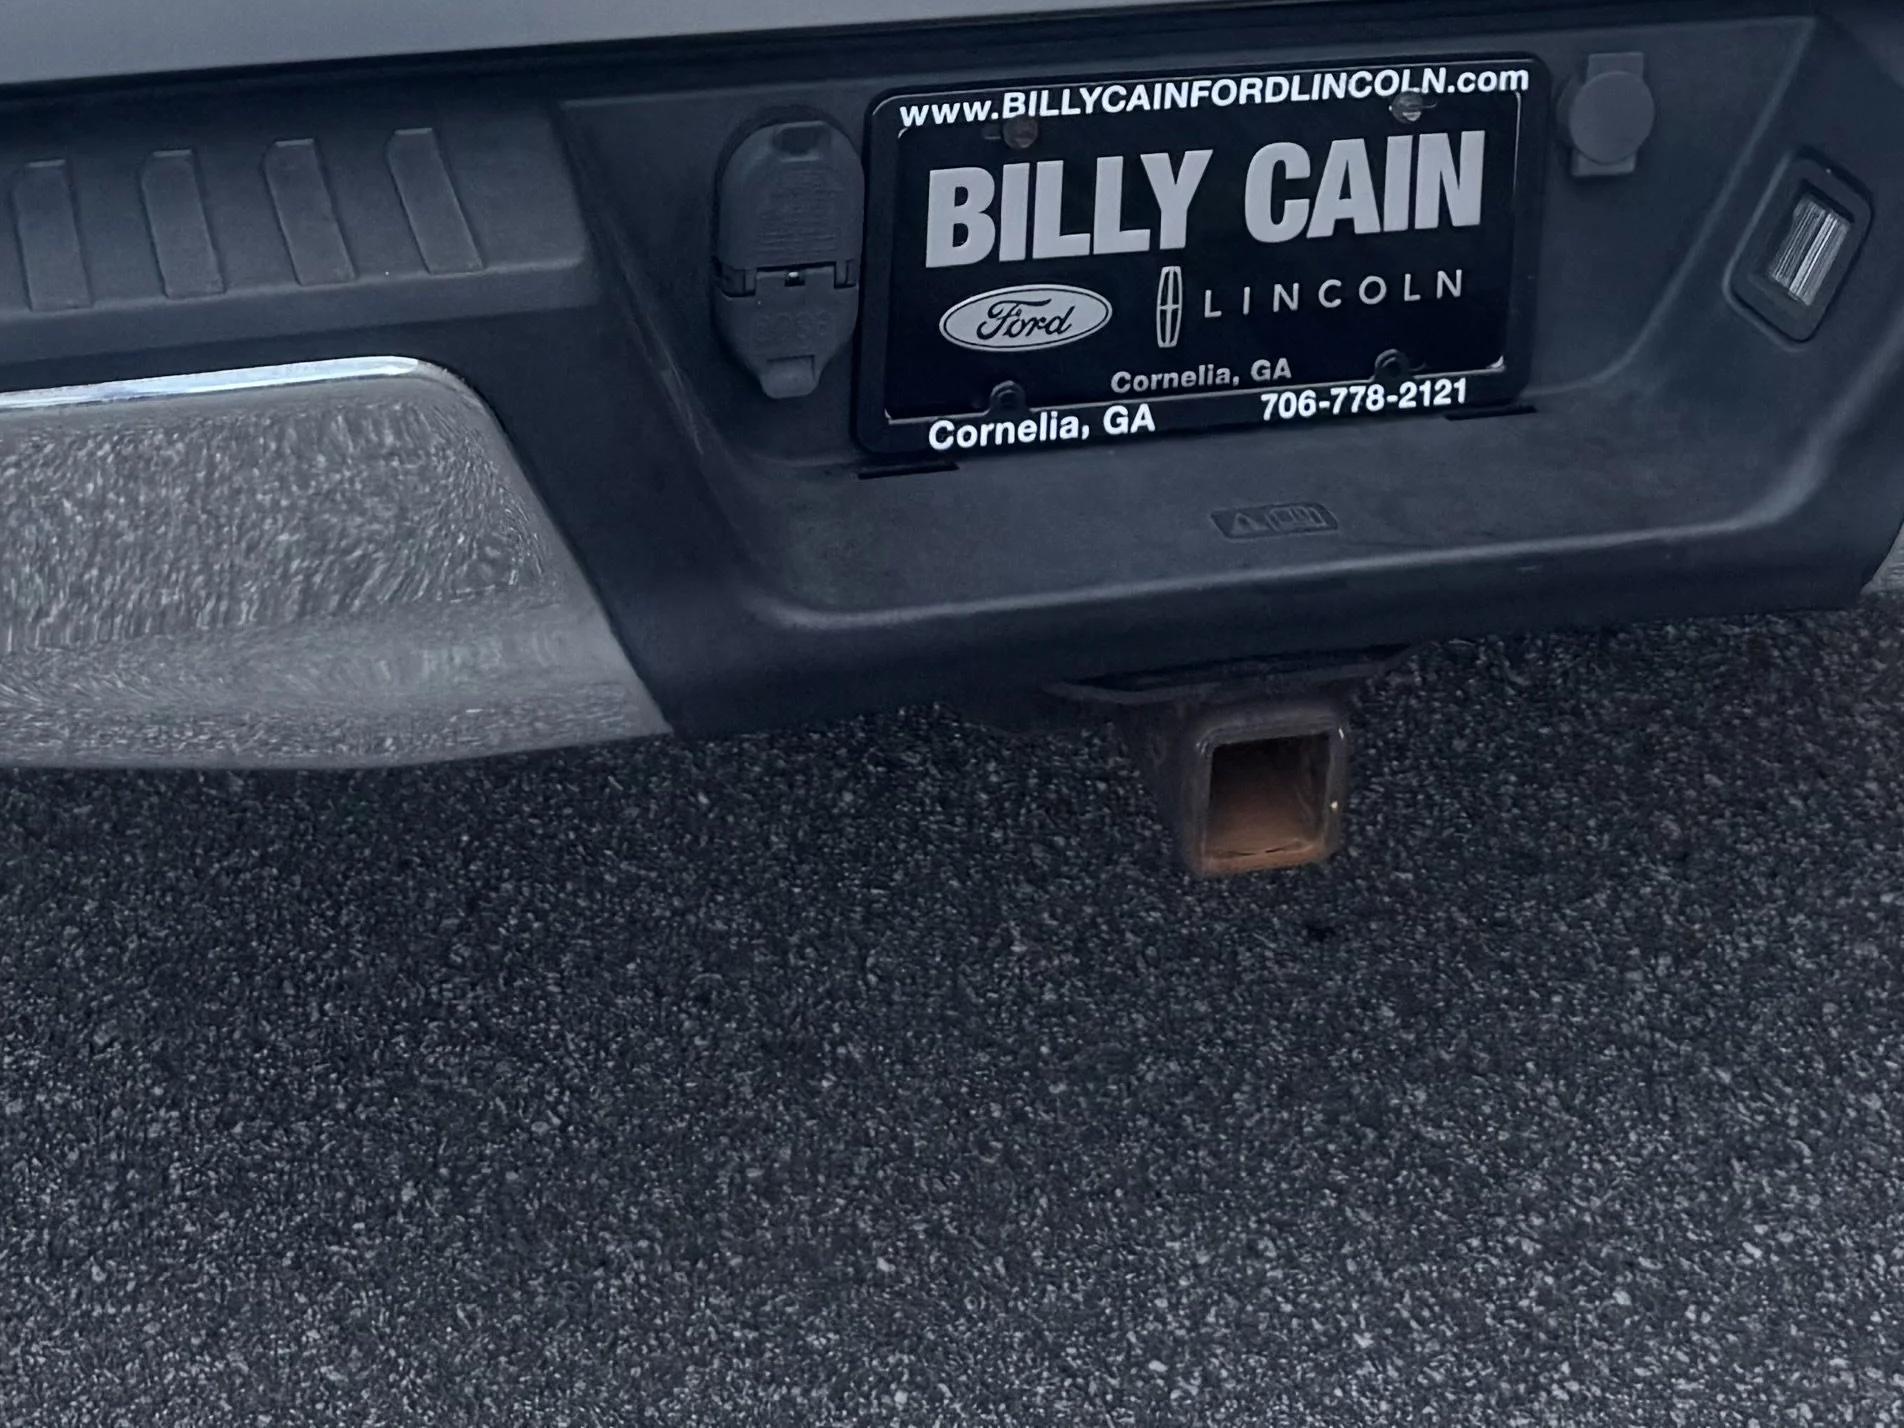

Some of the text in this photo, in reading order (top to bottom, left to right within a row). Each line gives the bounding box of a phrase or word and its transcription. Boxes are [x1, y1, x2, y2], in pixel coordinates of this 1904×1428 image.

[899, 66, 1530, 128] www.BILLYCAINFORDLINCOLN.com
[925, 148, 1214, 268] BILLY
[1244, 130, 1486, 244] CAIN
[975, 269, 1463, 341] Ford LINCOLN
[1110, 357, 1292, 393] Cornelia, GA
[928, 377, 1467, 451] Cornelia, GA 706-778-2121
